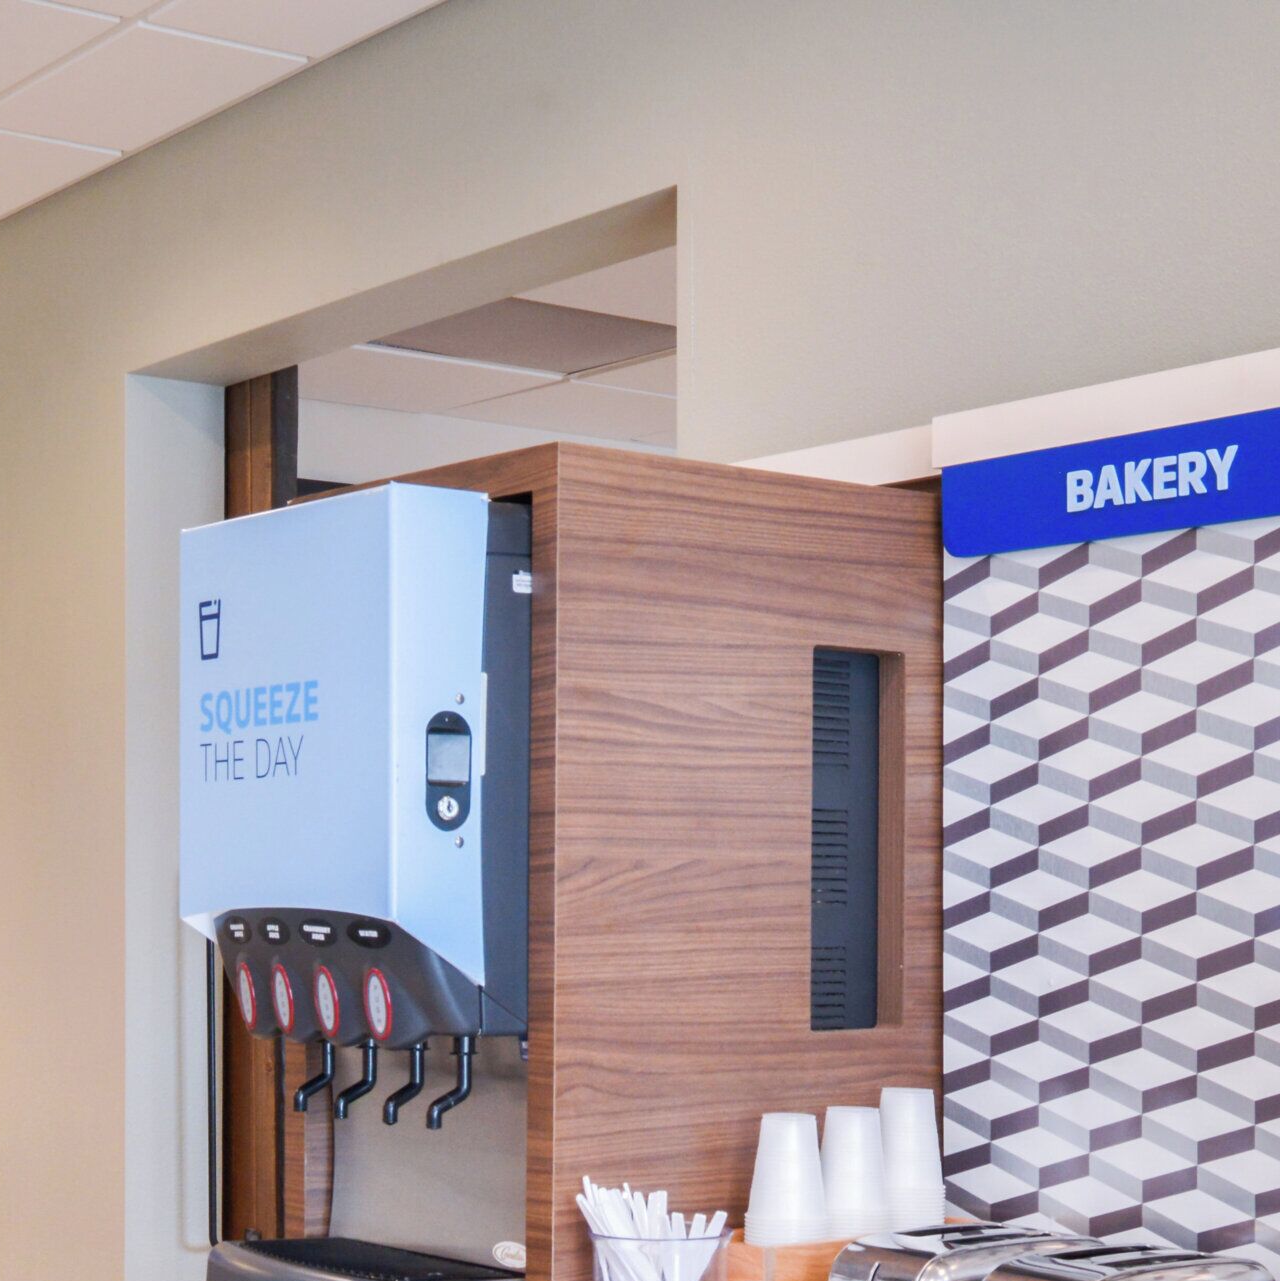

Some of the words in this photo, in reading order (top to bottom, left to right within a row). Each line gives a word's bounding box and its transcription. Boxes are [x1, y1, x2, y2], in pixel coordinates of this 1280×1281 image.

[1066, 444, 1239, 513] BAKERY
[199, 680, 320, 734] SQUEEZE
[200, 740, 245, 782] THE
[255, 735, 304, 779] DAY
